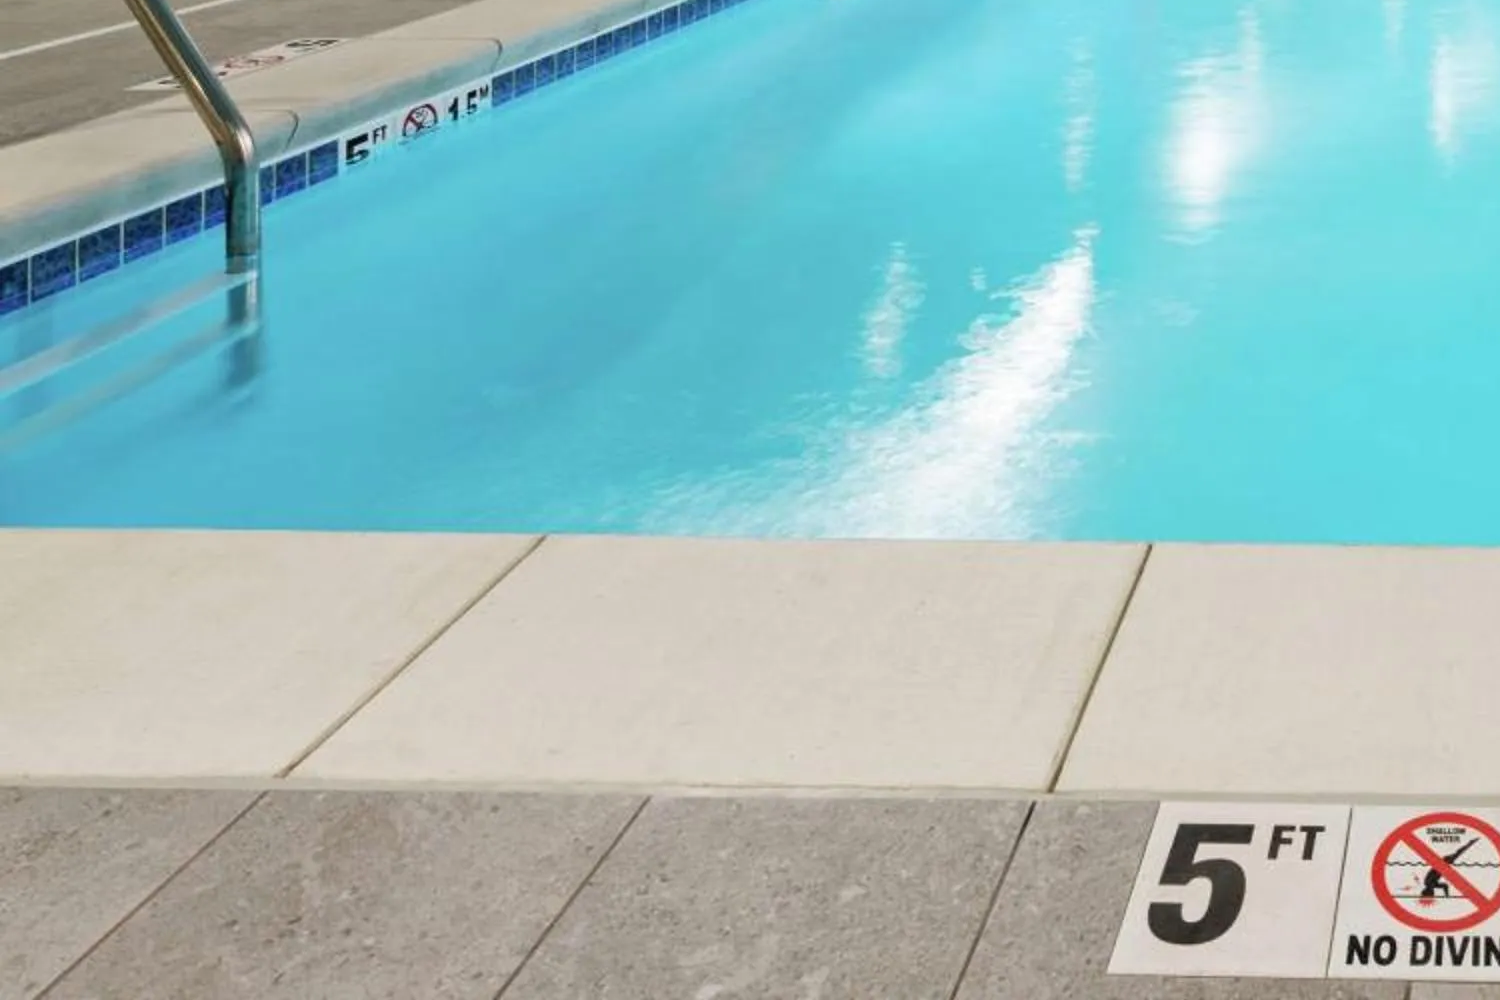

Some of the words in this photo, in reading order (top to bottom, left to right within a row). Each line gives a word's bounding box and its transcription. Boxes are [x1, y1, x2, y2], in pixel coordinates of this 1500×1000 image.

[345, 132, 370, 166] 5
[372, 125, 388, 145] FT
[1431, 835, 1461, 843] WATER
[1148, 823, 1255, 945] 5
[1267, 825, 1326, 861] FT
[1346, 935, 1397, 966] NO
